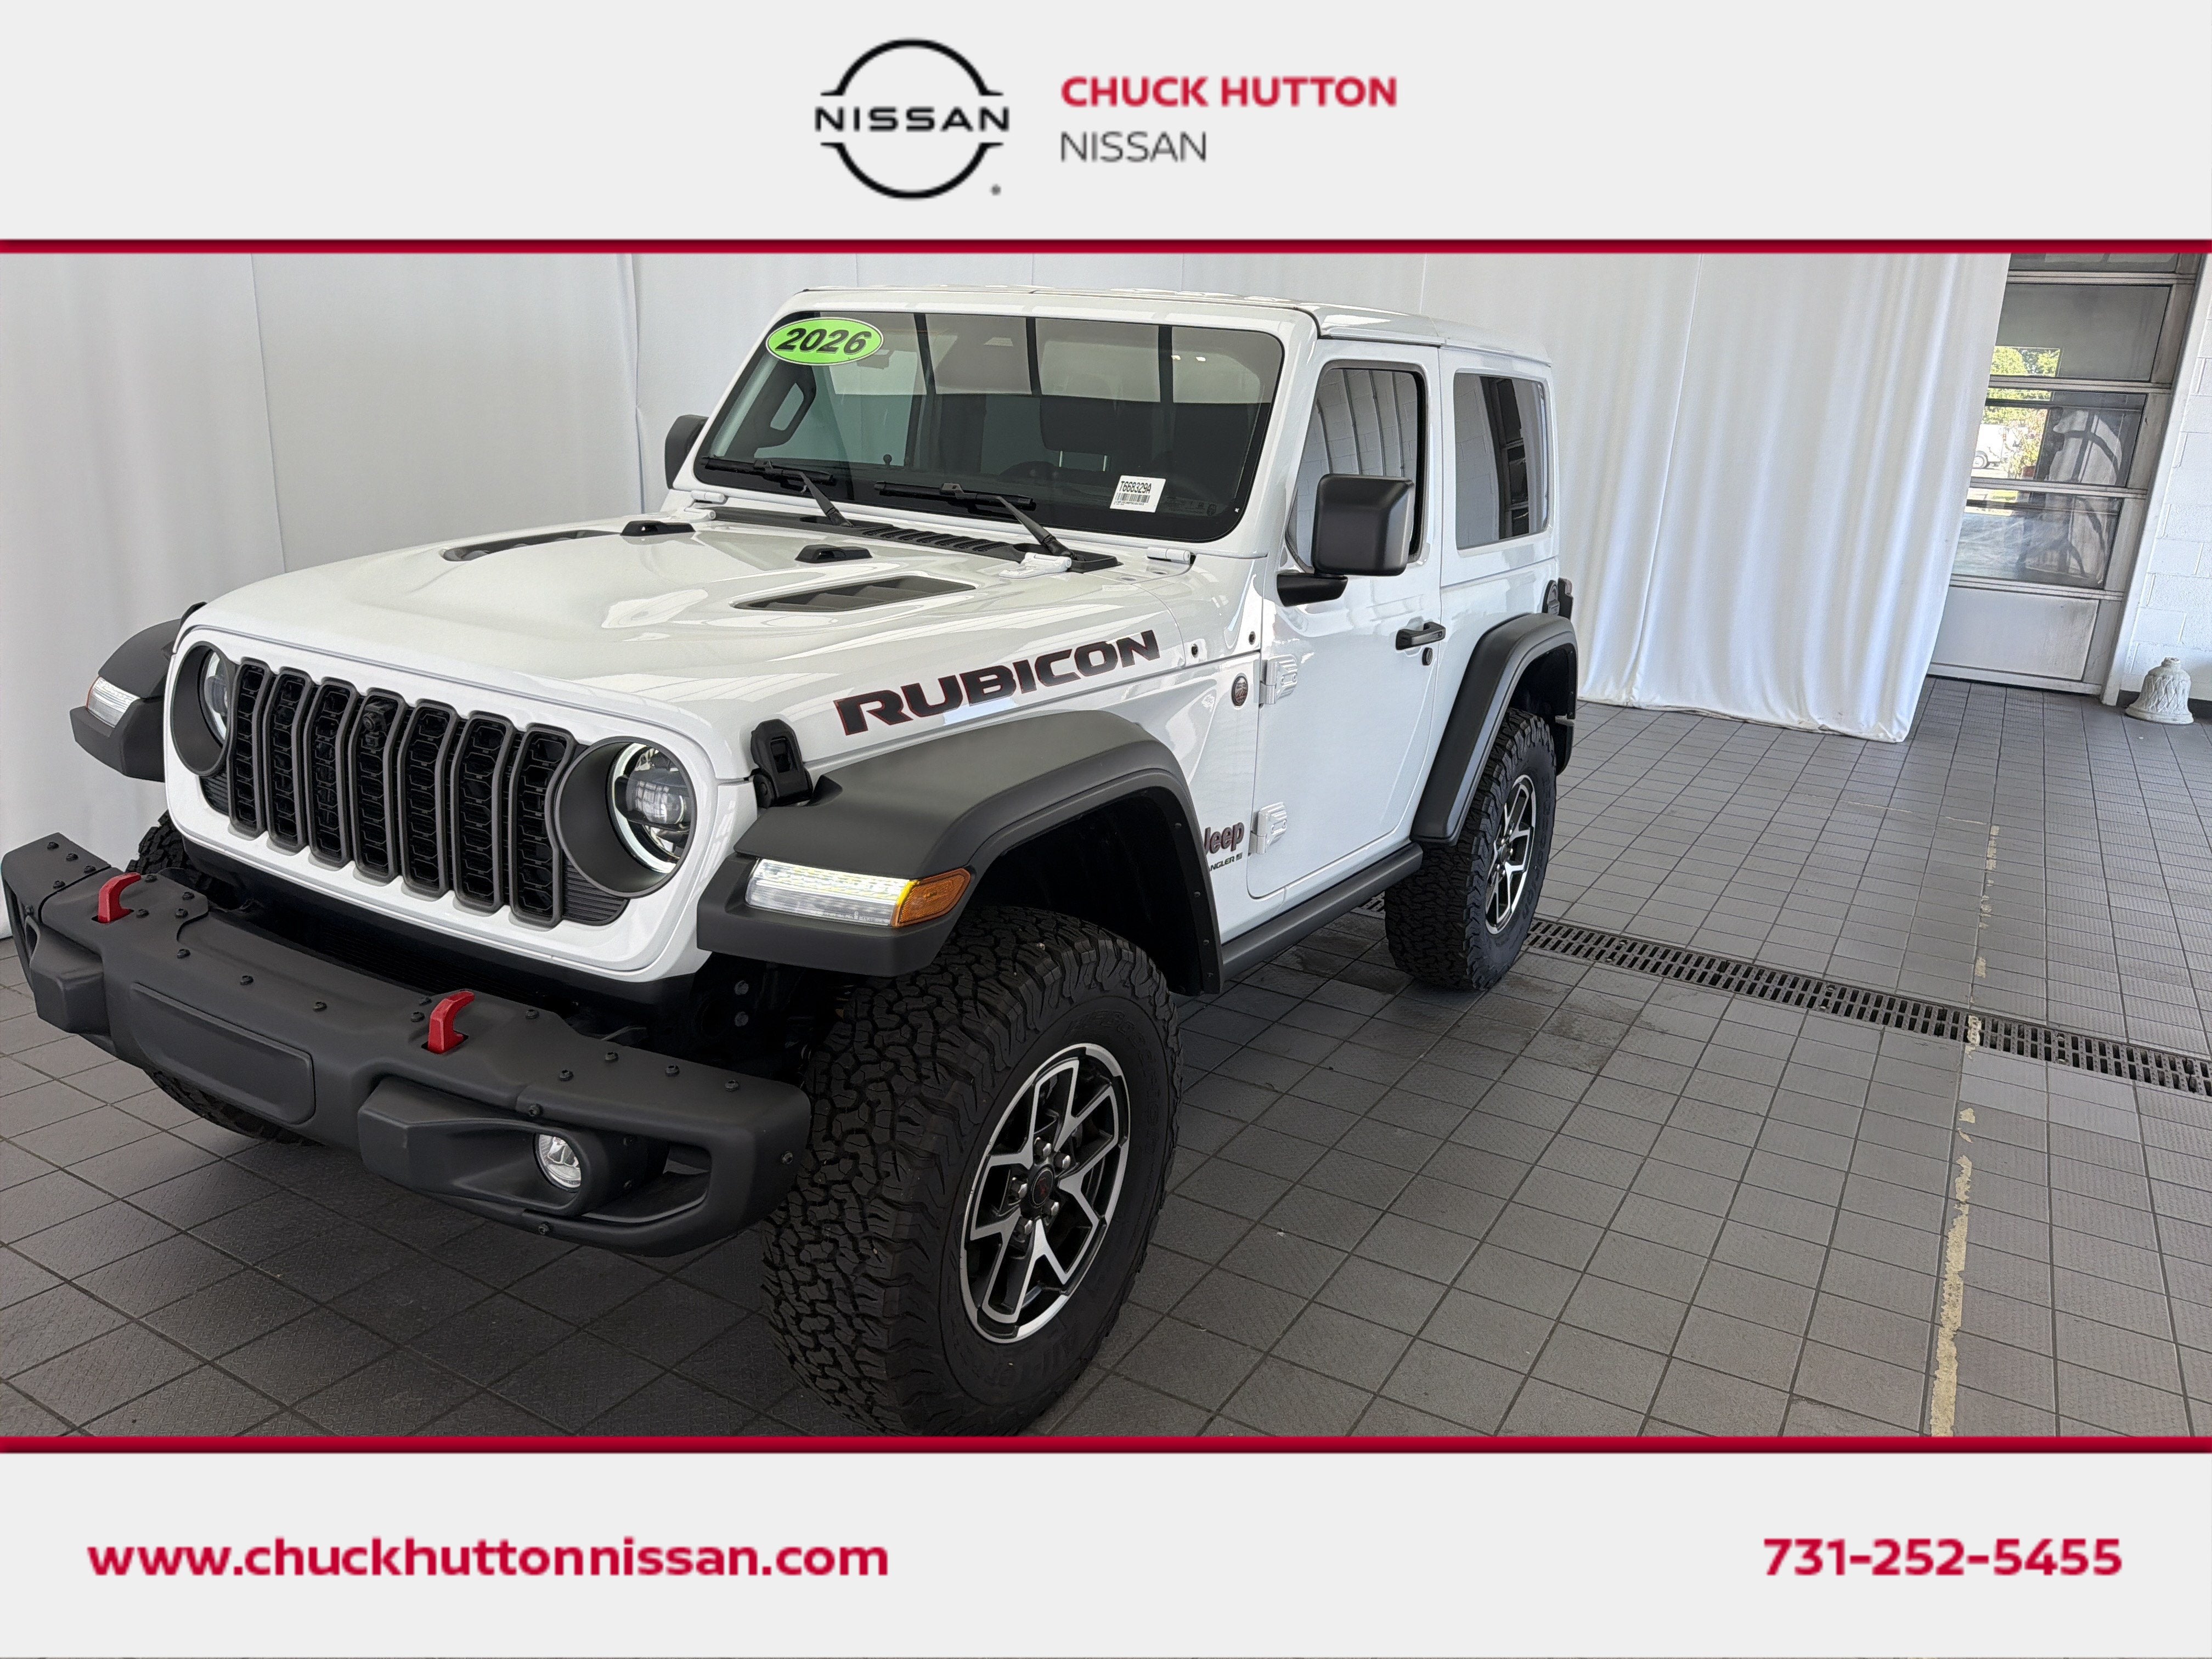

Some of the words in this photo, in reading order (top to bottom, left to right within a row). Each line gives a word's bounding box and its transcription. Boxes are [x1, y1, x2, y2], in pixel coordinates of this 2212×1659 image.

[775, 328, 872, 356] 2026
[1119, 481, 1152, 494] T668329A
[833, 629, 1160, 736] RUBICON
[1209, 856, 1235, 871] NGLER
